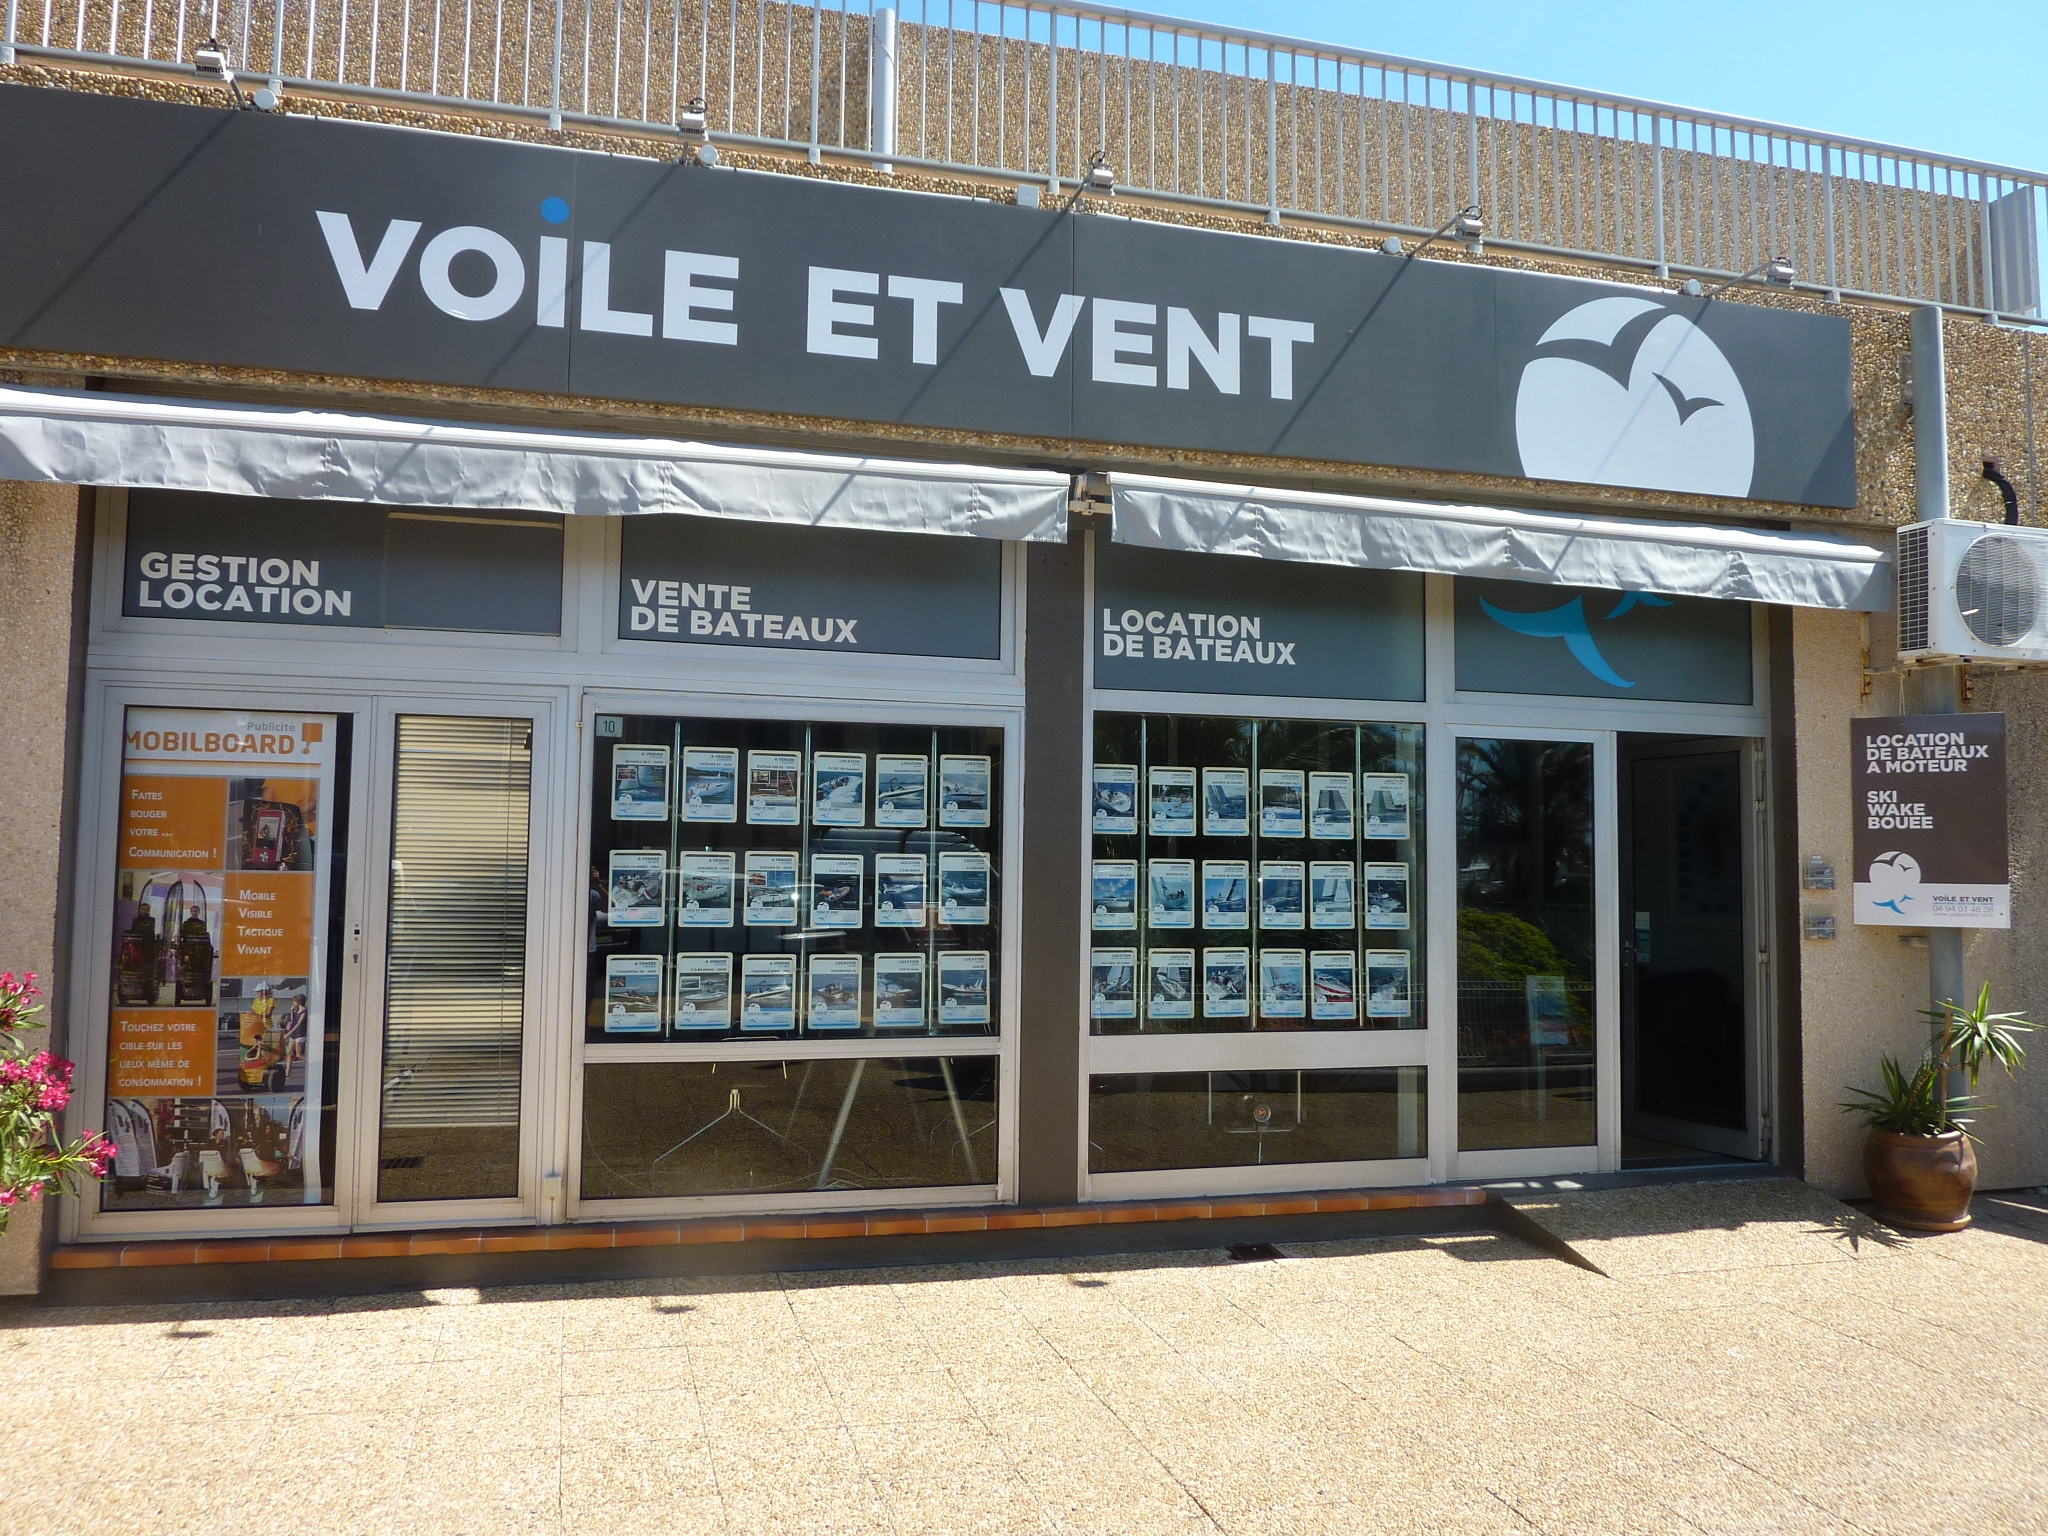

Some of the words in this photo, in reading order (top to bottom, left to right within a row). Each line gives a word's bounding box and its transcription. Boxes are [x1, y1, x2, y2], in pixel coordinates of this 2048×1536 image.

[315, 197, 739, 346] VOILE
[807, 265, 963, 365] ET
[999, 287, 1314, 400] VENT
[140, 552, 319, 587] GESTION
[139, 581, 351, 616] LOCATION
[631, 579, 751, 611] VENTE
[631, 606, 679, 633] DE
[690, 609, 858, 643] BATEAUX
[1103, 608, 1260, 639] LOCATION
[1103, 634, 1143, 657] DE
[1153, 636, 1296, 665] BATEAUX
[246, 721, 296, 732] Publicité
[603, 720, 616, 733] 10
[126, 730, 295, 755] MOBILBOARD
[1866, 732, 1965, 747] LOCATION
[1866, 747, 1891, 761] DE
[1896, 745, 1989, 760] BATEAUX
[1866, 761, 1881, 773] A
[1886, 759, 1967, 773] MOTEUR
[1867, 790, 1897, 803] SKI
[130, 810, 167, 819] BOUGER
[1867, 803, 1925, 816] WAKE
[1868, 816, 1933, 829] BOUEE
[130, 828, 158, 837] VOTRE
[212, 848, 217, 858] !
[1957, 905, 1967, 913] 01
[168, 1023, 197, 1032] VOTRE
[120, 1041, 145, 1050] CIBLE
[147, 1041, 164, 1050] SUR
[168, 1042, 182, 1050] LES
[120, 1060, 144, 1069] LIEUX
[178, 1060, 190, 1069] DE
[119, 1077, 193, 1087] CONSOMMATION
[198, 1075, 202, 1086] !
